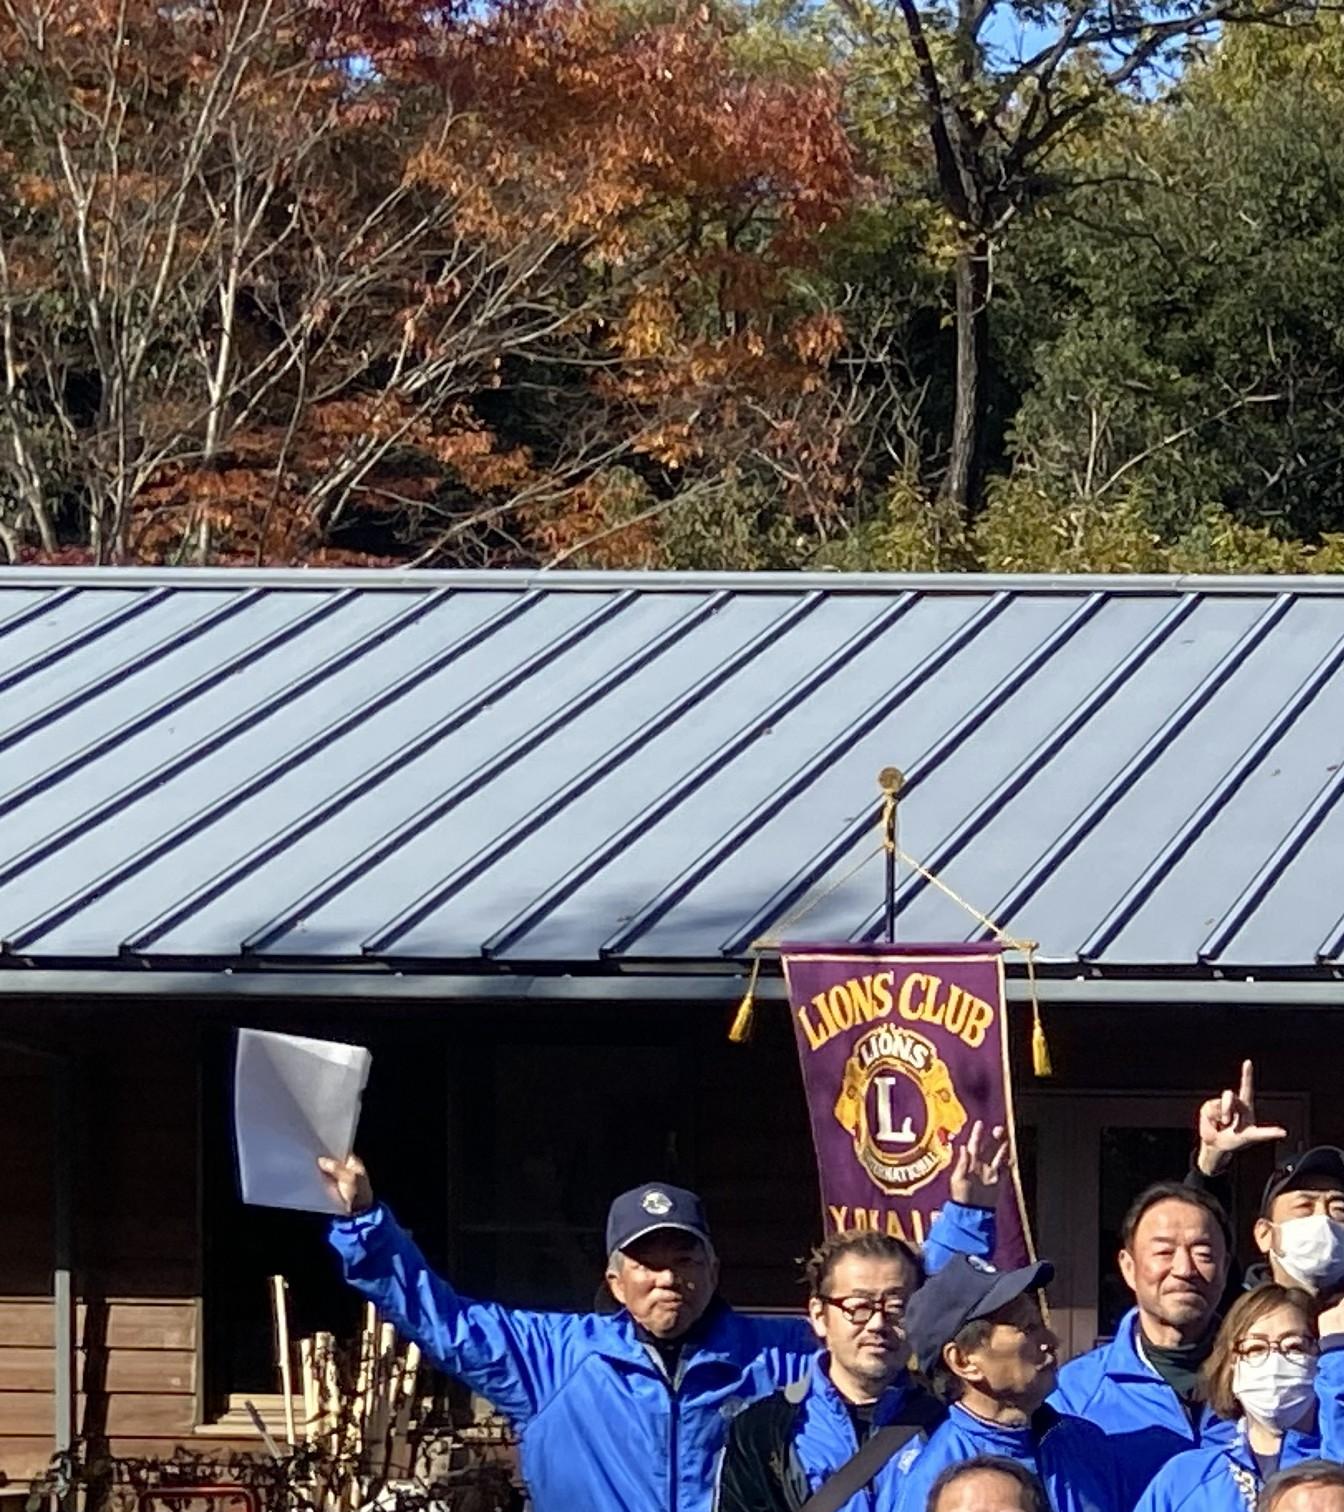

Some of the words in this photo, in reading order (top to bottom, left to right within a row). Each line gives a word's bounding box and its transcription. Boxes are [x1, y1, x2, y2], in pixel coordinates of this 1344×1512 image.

[799, 970, 894, 1051] LIONS
[898, 972, 995, 1048] CLUB
[859, 1030, 931, 1070] LIONS
[873, 1076, 917, 1143] L
